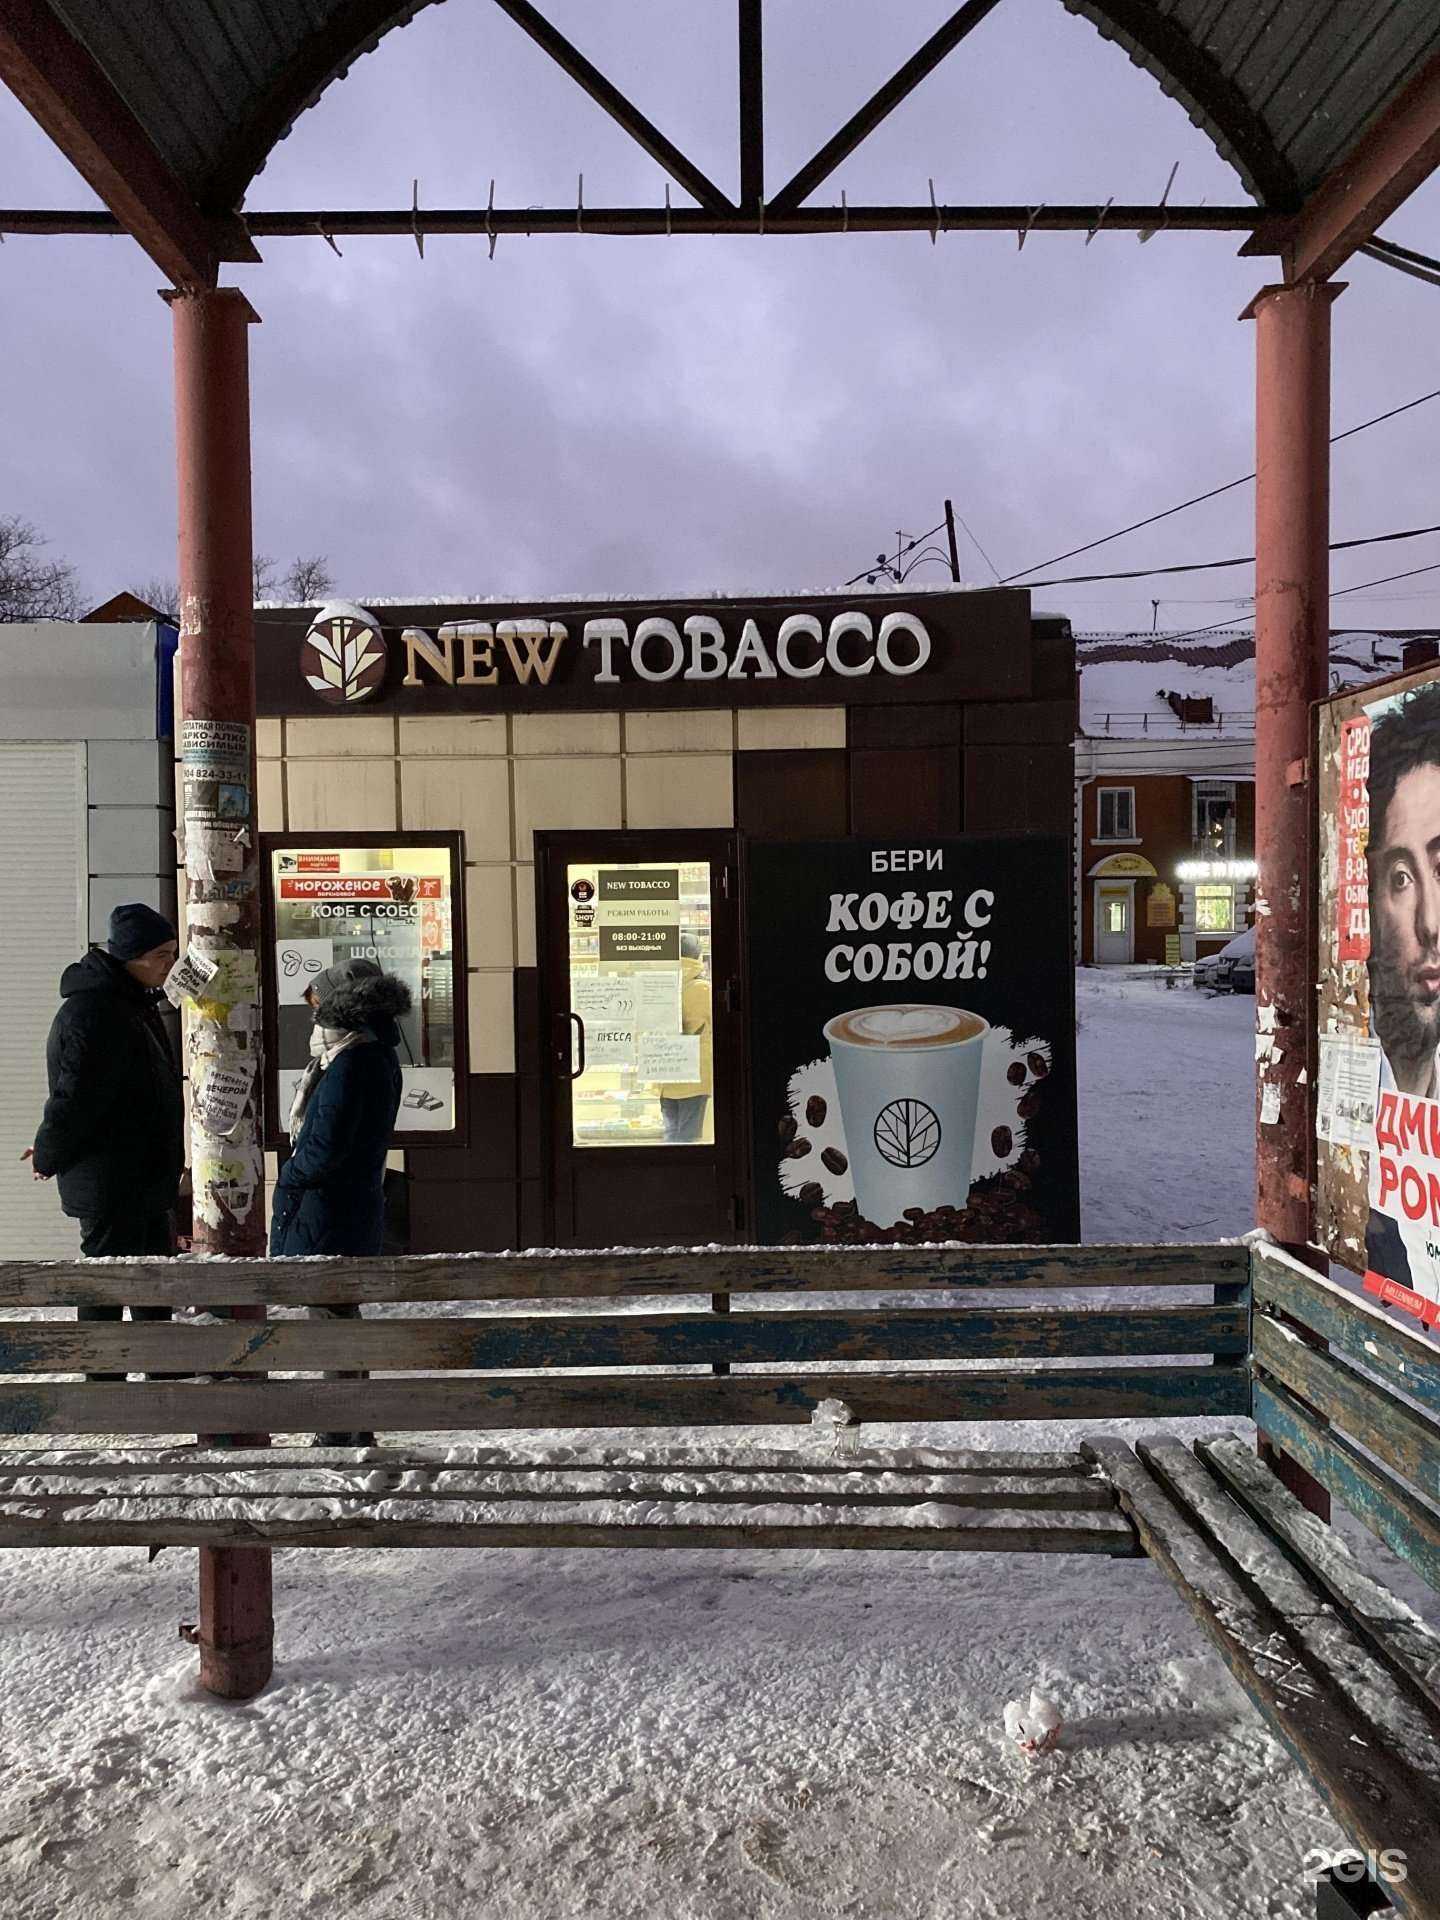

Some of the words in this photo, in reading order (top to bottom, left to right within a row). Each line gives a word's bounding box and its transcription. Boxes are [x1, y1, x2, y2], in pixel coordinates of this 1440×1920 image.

[401, 620, 568, 686] NEW
[583, 612, 931, 683] TOBACCO
[871, 849, 943, 873] БЕРИ
[607, 882, 626, 890] NEW
[629, 881, 671, 889] TOBACCO
[311, 904, 355, 918] КОФЕ
[360, 904, 371, 918] С
[825, 890, 953, 932] КОФЕ
[964, 889, 994, 928] С
[612, 932, 666, 941] 08:00-21:00
[824, 930, 992, 983] СОБОЙ!
